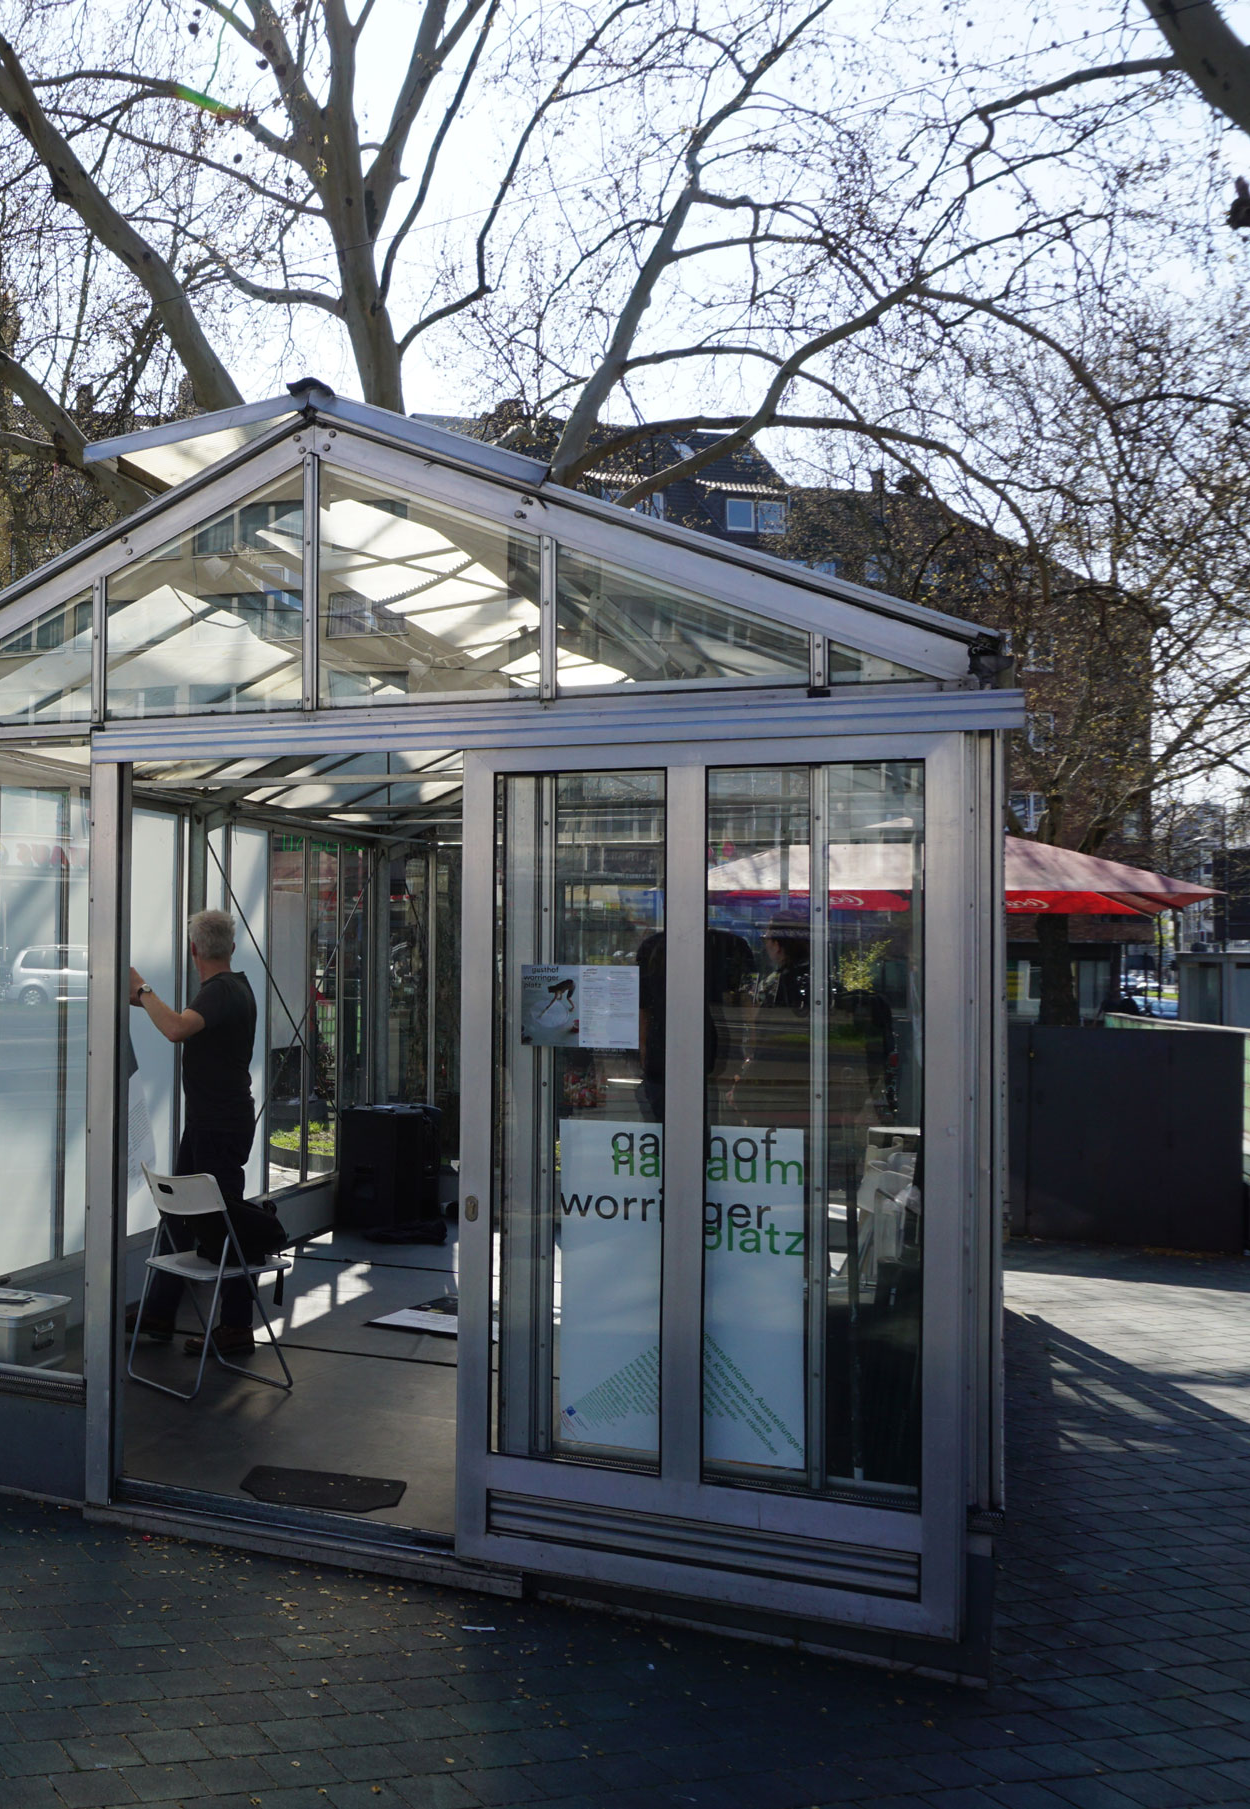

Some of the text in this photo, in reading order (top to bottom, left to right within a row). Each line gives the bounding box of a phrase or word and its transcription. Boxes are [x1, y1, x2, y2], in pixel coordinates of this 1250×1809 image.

[523, 974, 559, 982] worringer
[531, 966, 559, 974] gasthof
[703, 1333, 755, 1397] minstallationen,
[755, 1397, 804, 1456] Ausstellungen,
[713, 1362, 773, 1433] Klangexperimente
